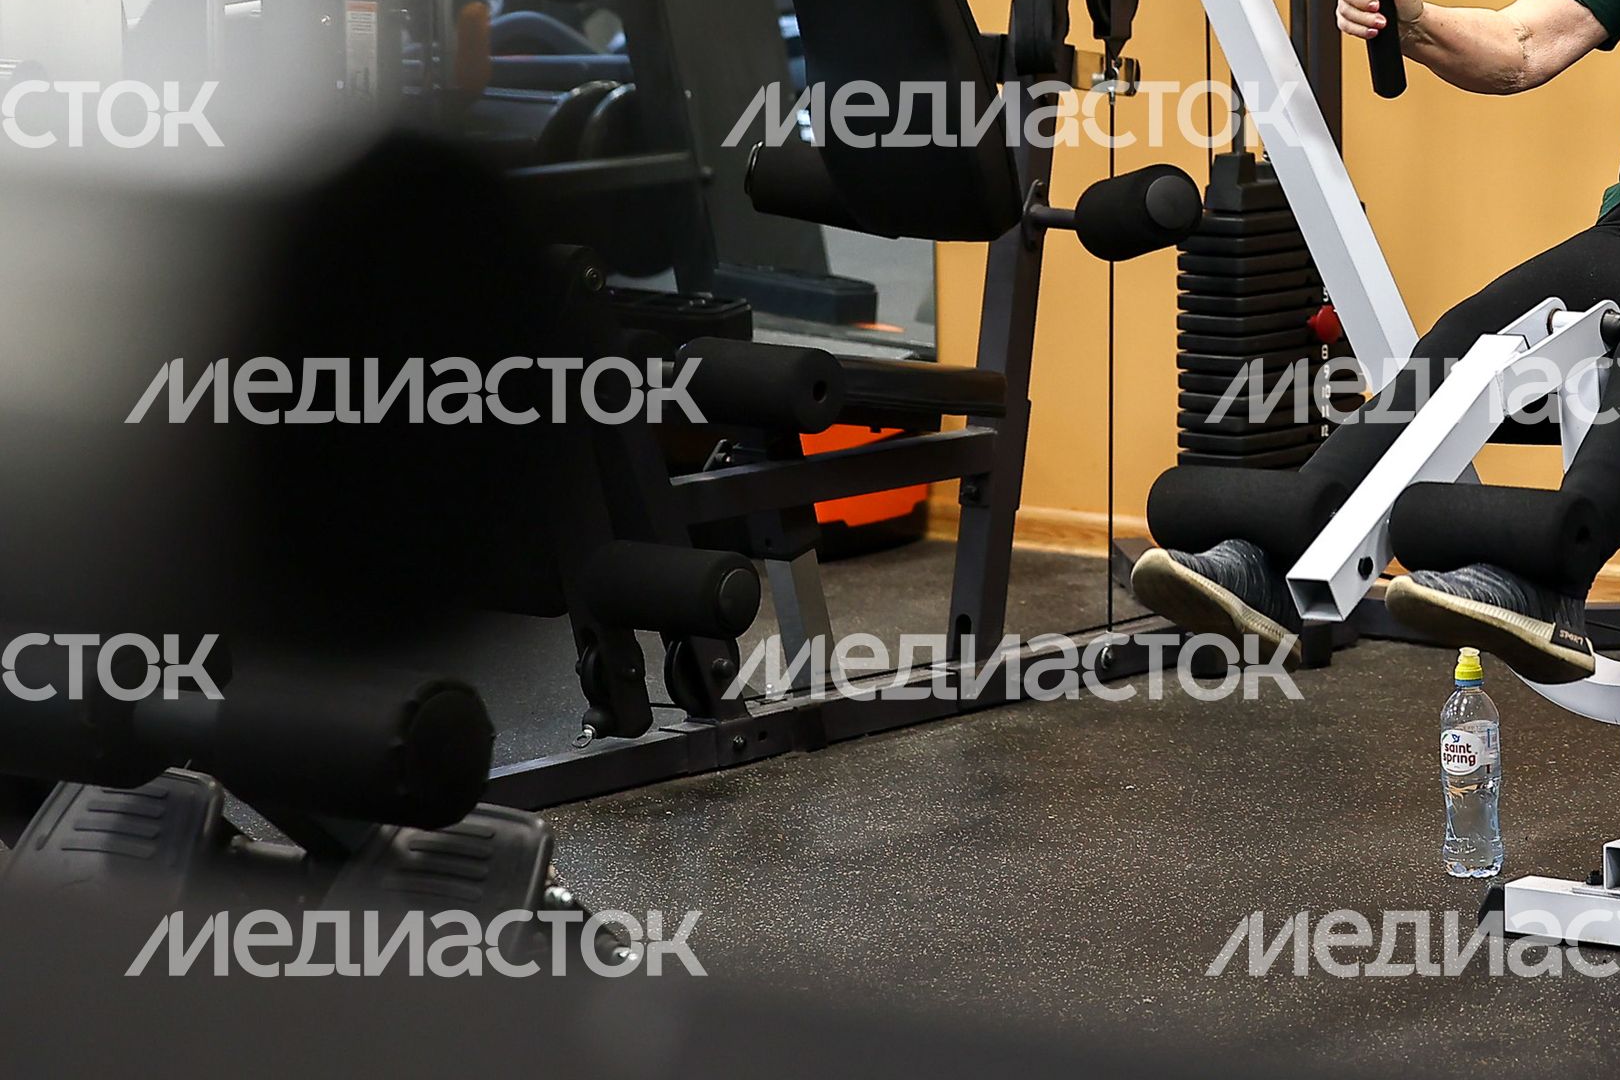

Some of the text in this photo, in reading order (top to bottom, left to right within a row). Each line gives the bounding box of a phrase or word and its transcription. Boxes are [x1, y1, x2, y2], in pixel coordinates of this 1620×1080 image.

[1321, 344, 1329, 360] 8
[1323, 365, 1330, 379] 9
[1321, 385, 1331, 399] 10
[1321, 405, 1329, 418] 11
[1444, 743, 1472, 753] saint
[1443, 753, 1475, 766] spring
